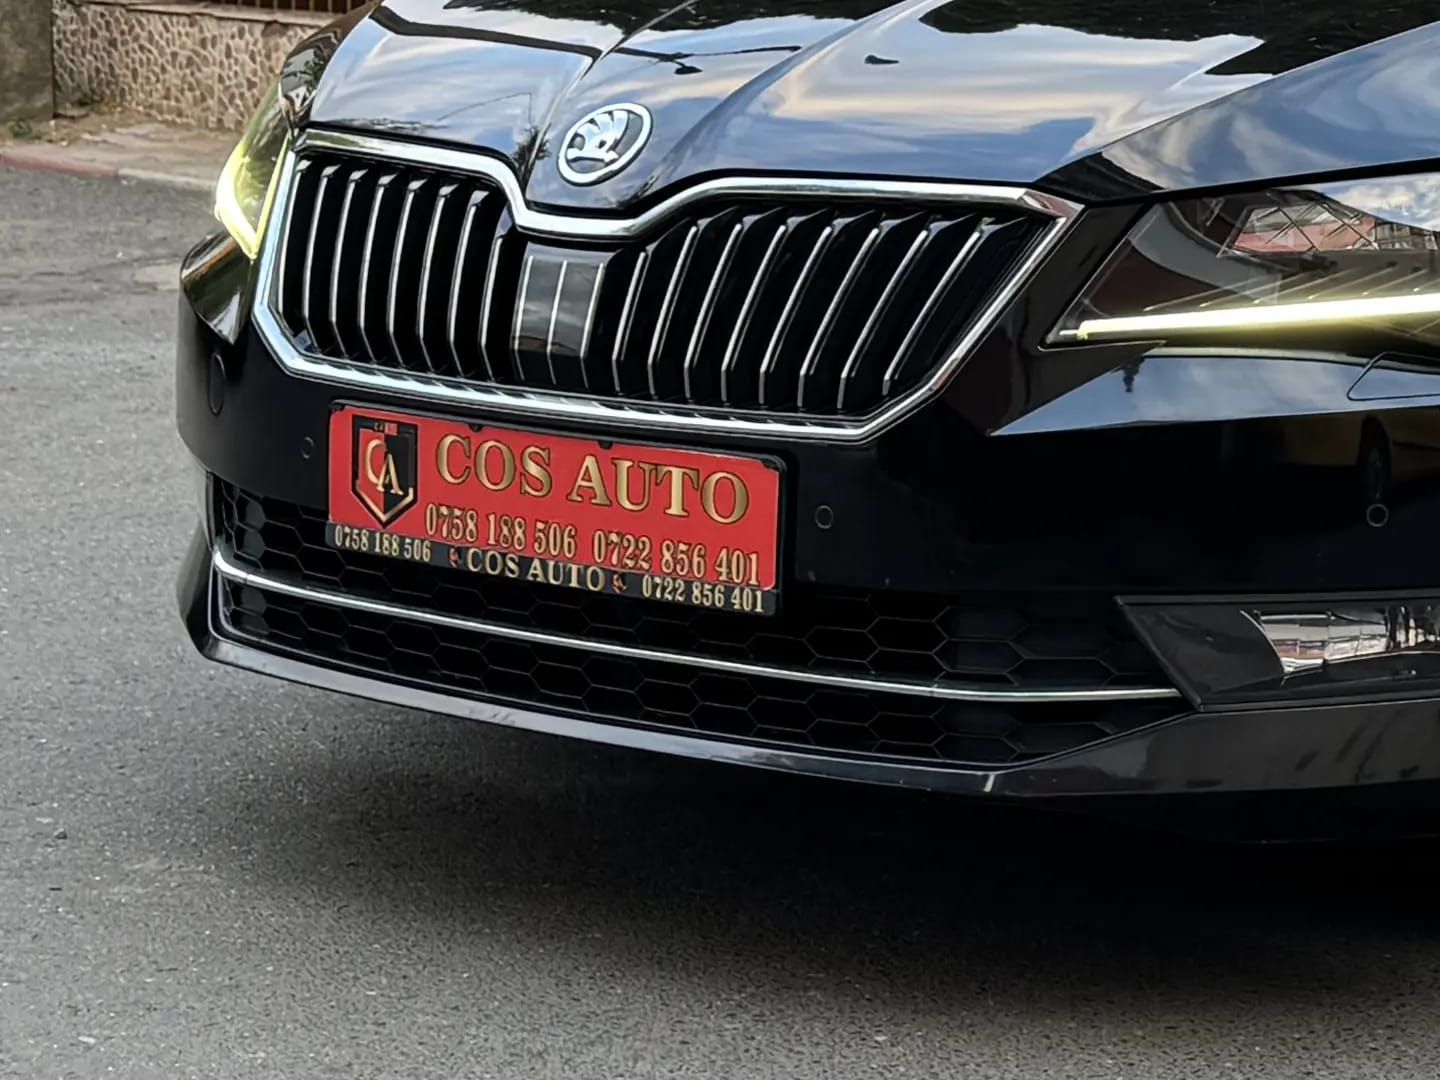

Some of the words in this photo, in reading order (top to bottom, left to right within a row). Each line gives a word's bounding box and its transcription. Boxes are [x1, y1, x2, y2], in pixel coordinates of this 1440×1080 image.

[435, 433, 552, 498] COS
[566, 455, 750, 524] AUTO
[334, 525, 369, 552] 0758
[374, 531, 399, 556] 188
[403, 538, 431, 562] 506
[467, 548, 520, 578] COS
[527, 558, 605, 591] AUTO
[642, 574, 686, 601] 0722
[692, 582, 725, 608] 856
[731, 588, 764, 613] 401
[425, 503, 478, 543] 0758
[487, 513, 527, 551] 188
[533, 521, 576, 558] 506
[592, 530, 651, 570] 0722
[661, 539, 706, 579] 856
[714, 547, 760, 586] 401
